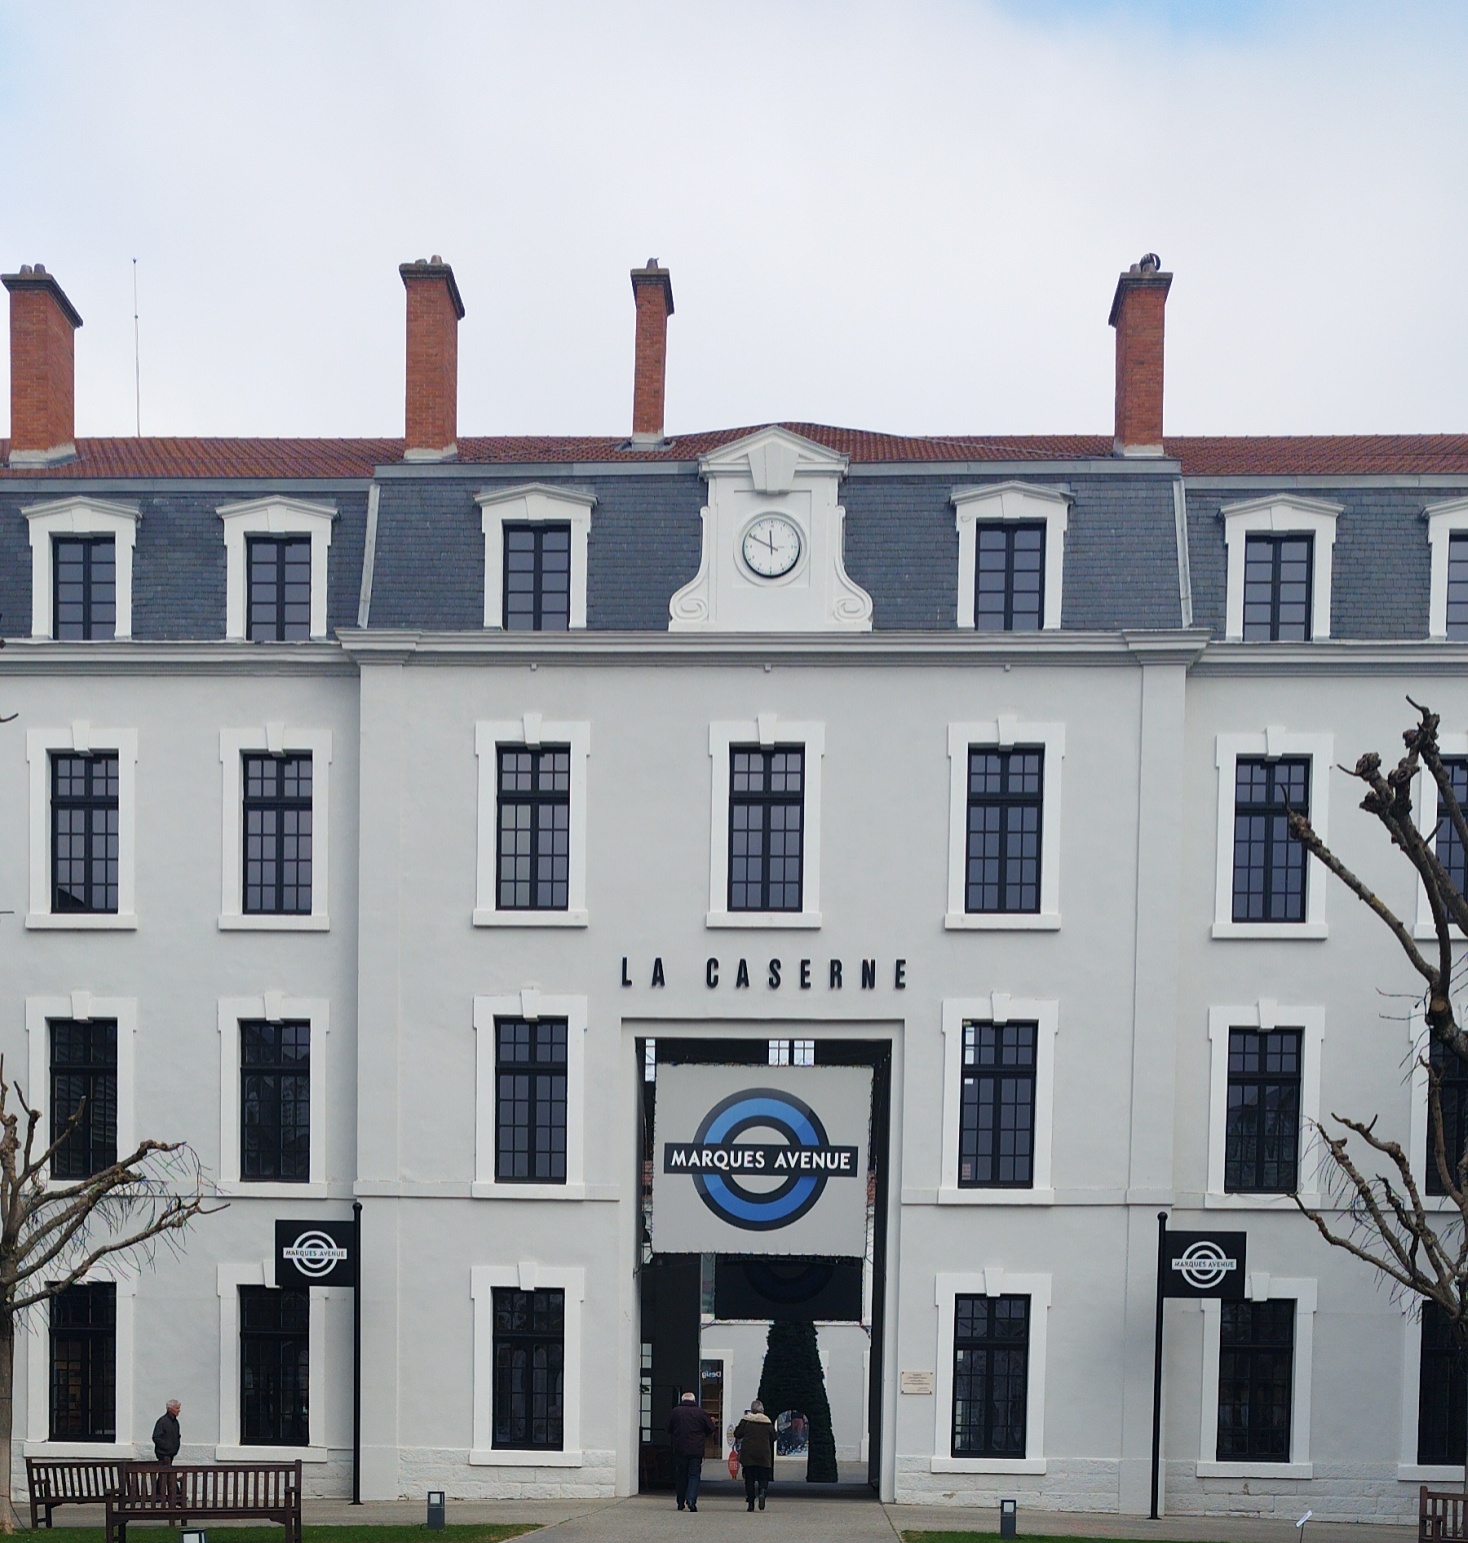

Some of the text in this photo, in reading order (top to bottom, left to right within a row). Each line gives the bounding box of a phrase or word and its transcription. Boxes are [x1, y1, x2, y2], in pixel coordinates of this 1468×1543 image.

[621, 956, 907, 991] LA CASERNE
[670, 1149, 851, 1171] MARQUES AVENUE
[285, 1249, 317, 1257] MARQUES
[1174, 1260, 1206, 1268] MARQUES
